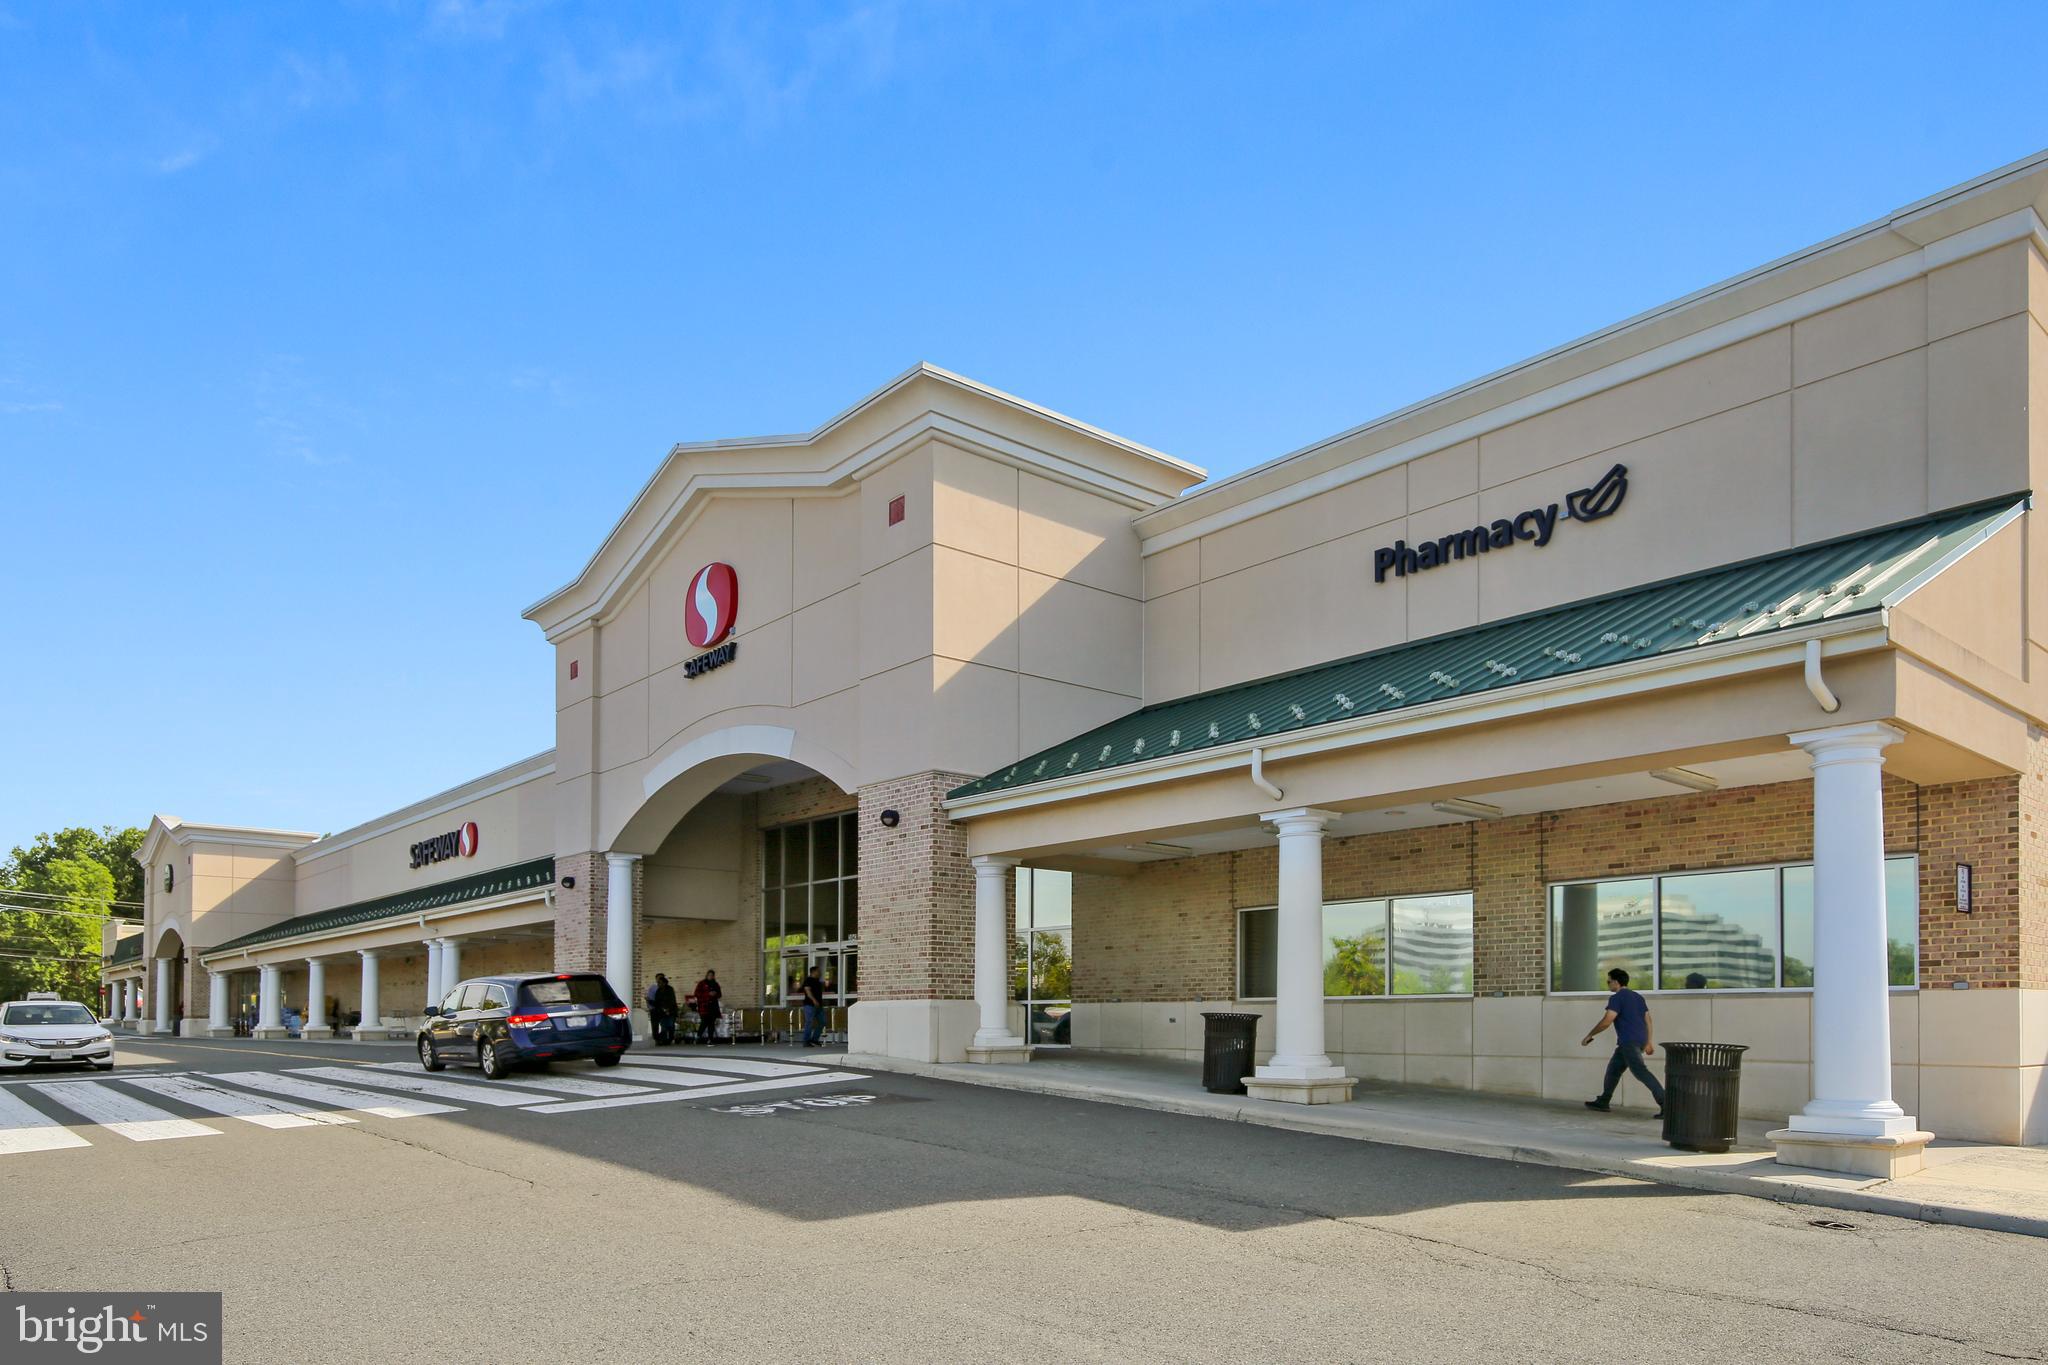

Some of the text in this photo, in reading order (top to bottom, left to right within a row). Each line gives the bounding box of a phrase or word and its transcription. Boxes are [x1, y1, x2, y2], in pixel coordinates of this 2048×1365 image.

[1374, 503, 1559, 583] Pharmacy
[684, 641, 737, 679] SAFEWAY
[410, 830, 461, 869] SAFEWAY
